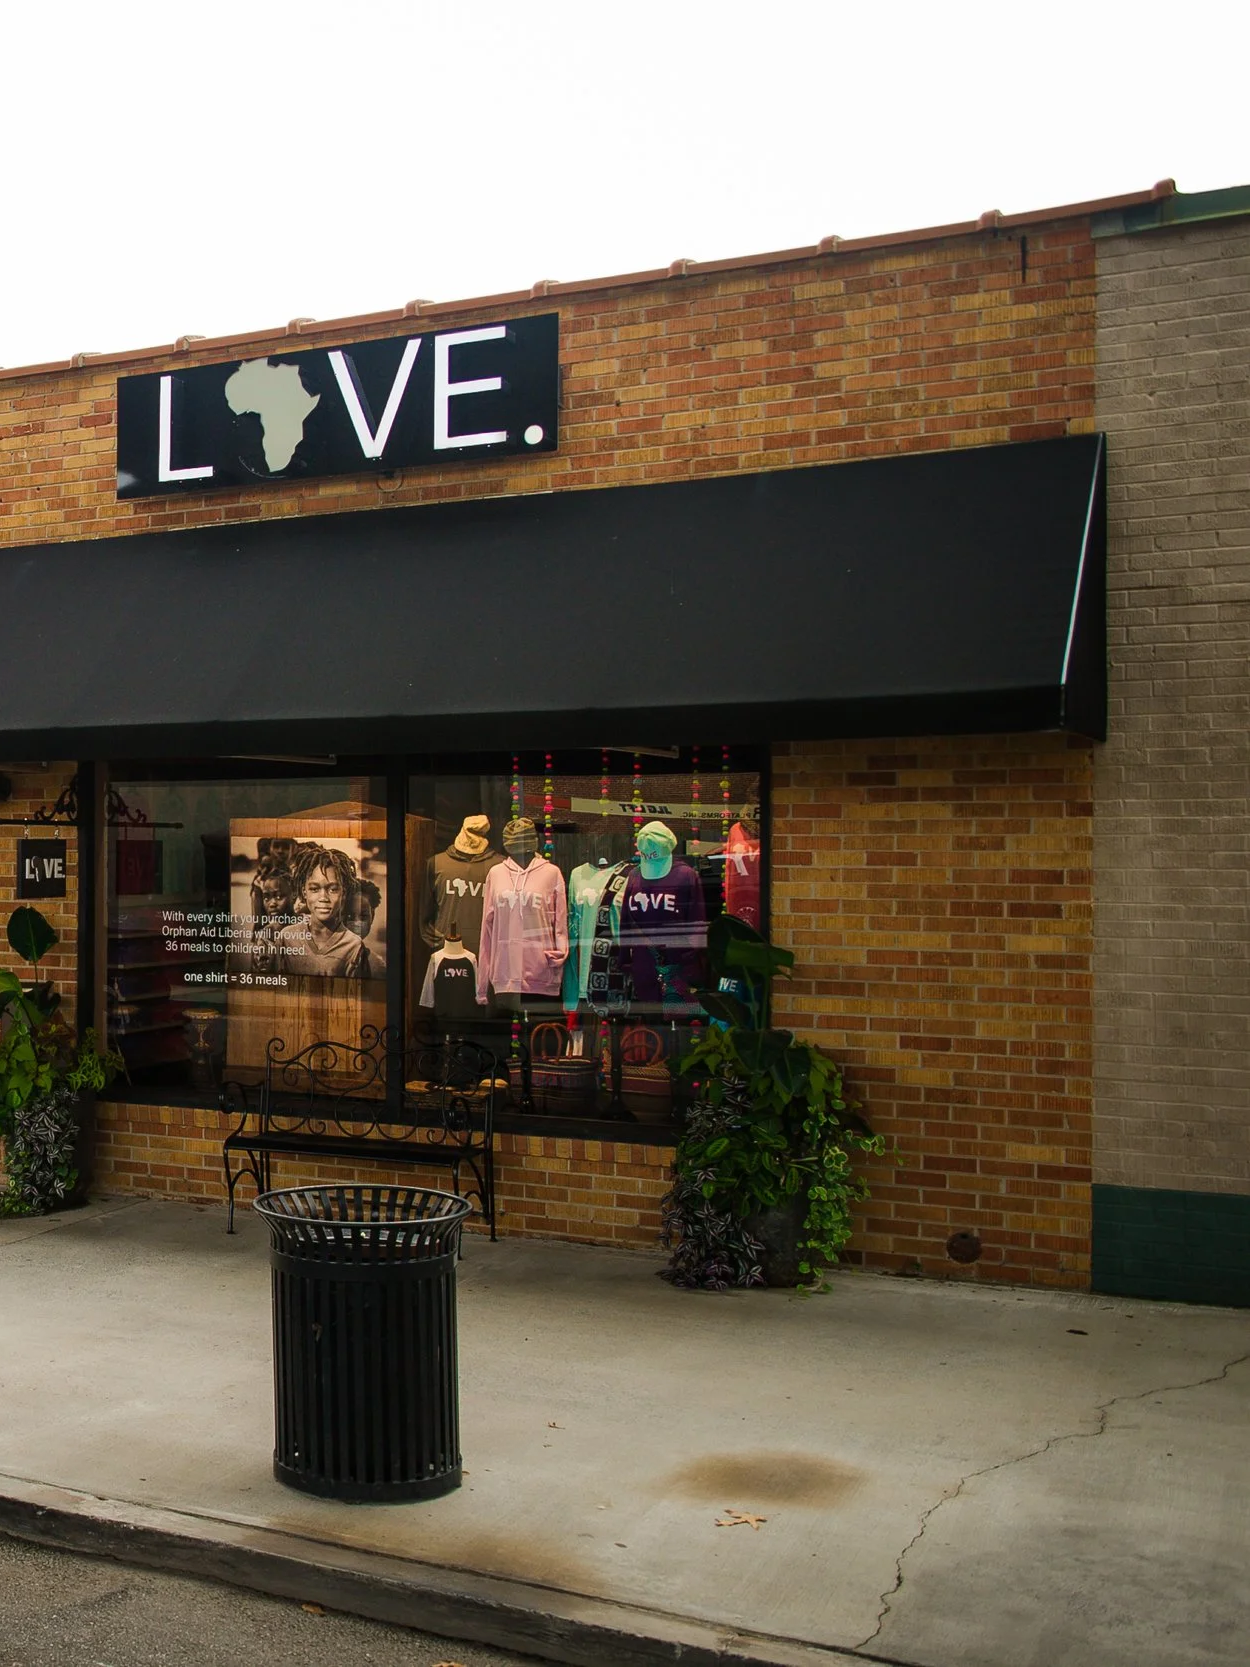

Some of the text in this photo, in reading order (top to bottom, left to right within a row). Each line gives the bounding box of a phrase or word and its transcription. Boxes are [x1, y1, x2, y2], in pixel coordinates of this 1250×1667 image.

[162, 911, 185, 922] With
[187, 912, 213, 925] every
[216, 912, 239, 923] shirt
[240, 914, 259, 925] you
[162, 926, 312, 942] Orphan Aid Liberia will provide
[165, 940, 307, 956] 36 meals to children in need.
[184, 973, 203, 982] one
[206, 972, 228, 983] shirt
[239, 974, 253, 984] 36
[255, 974, 288, 986] meals
